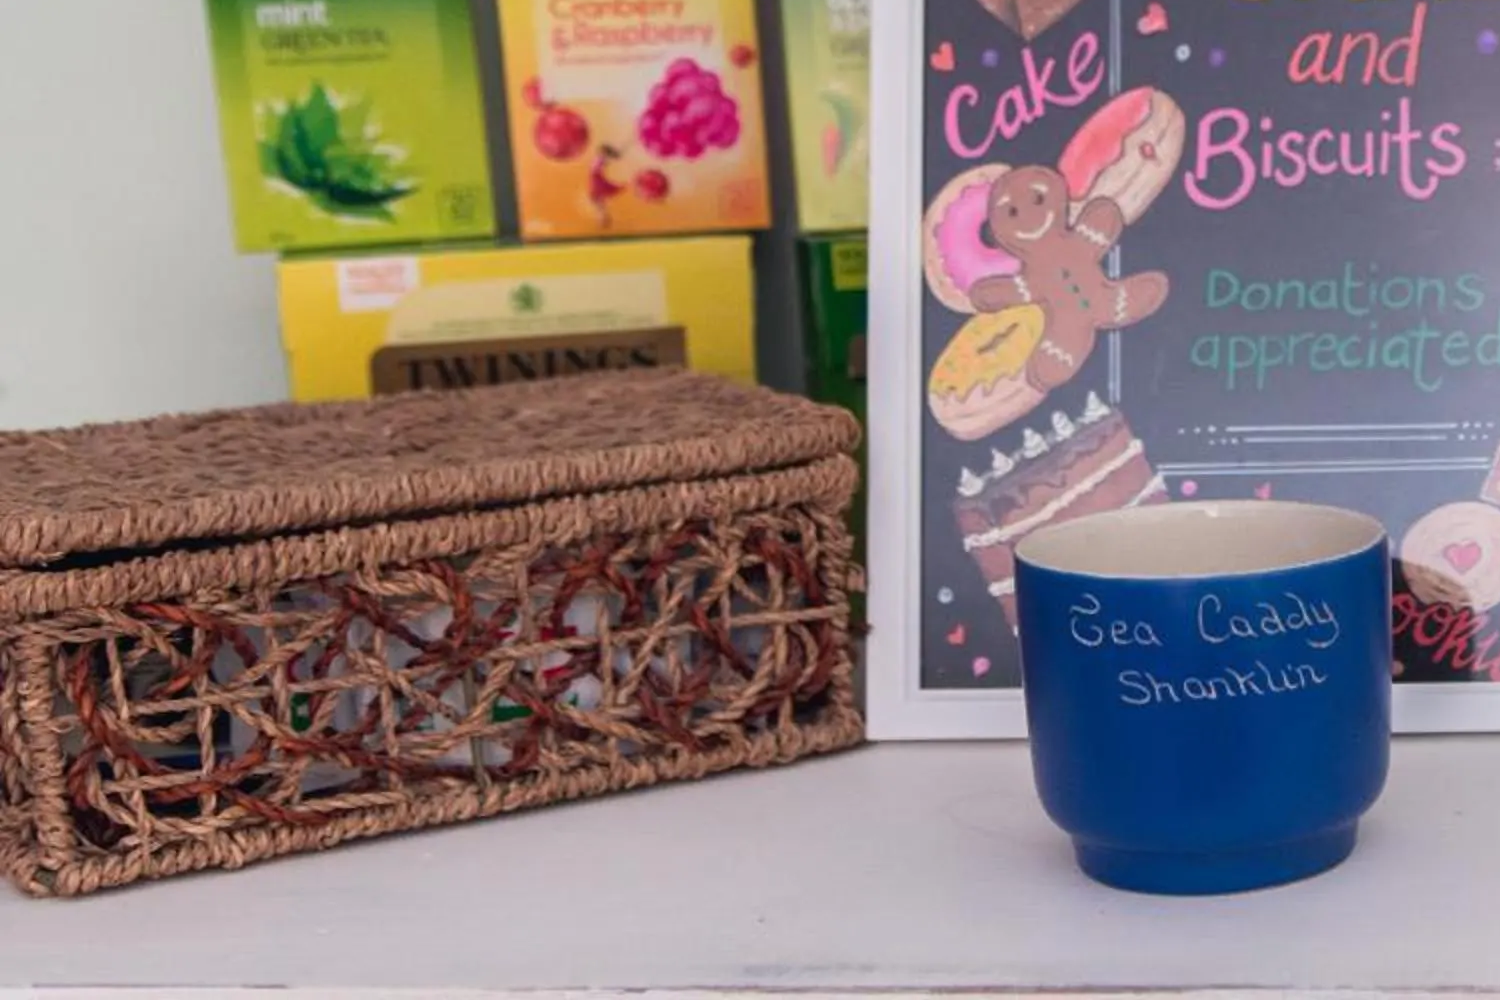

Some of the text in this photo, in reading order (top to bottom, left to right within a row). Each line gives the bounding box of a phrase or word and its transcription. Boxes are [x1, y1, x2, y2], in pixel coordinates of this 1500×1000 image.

[1287, 2, 1427, 87] and
[944, 31, 1105, 159] Cake
[1184, 97, 1467, 211] Biscuits
[1206, 261, 1487, 317] Donations
[401, 342, 658, 390] TWININGS
[1069, 592, 1341, 649] Tea Caddy
[1118, 660, 1329, 705] Shanklin
